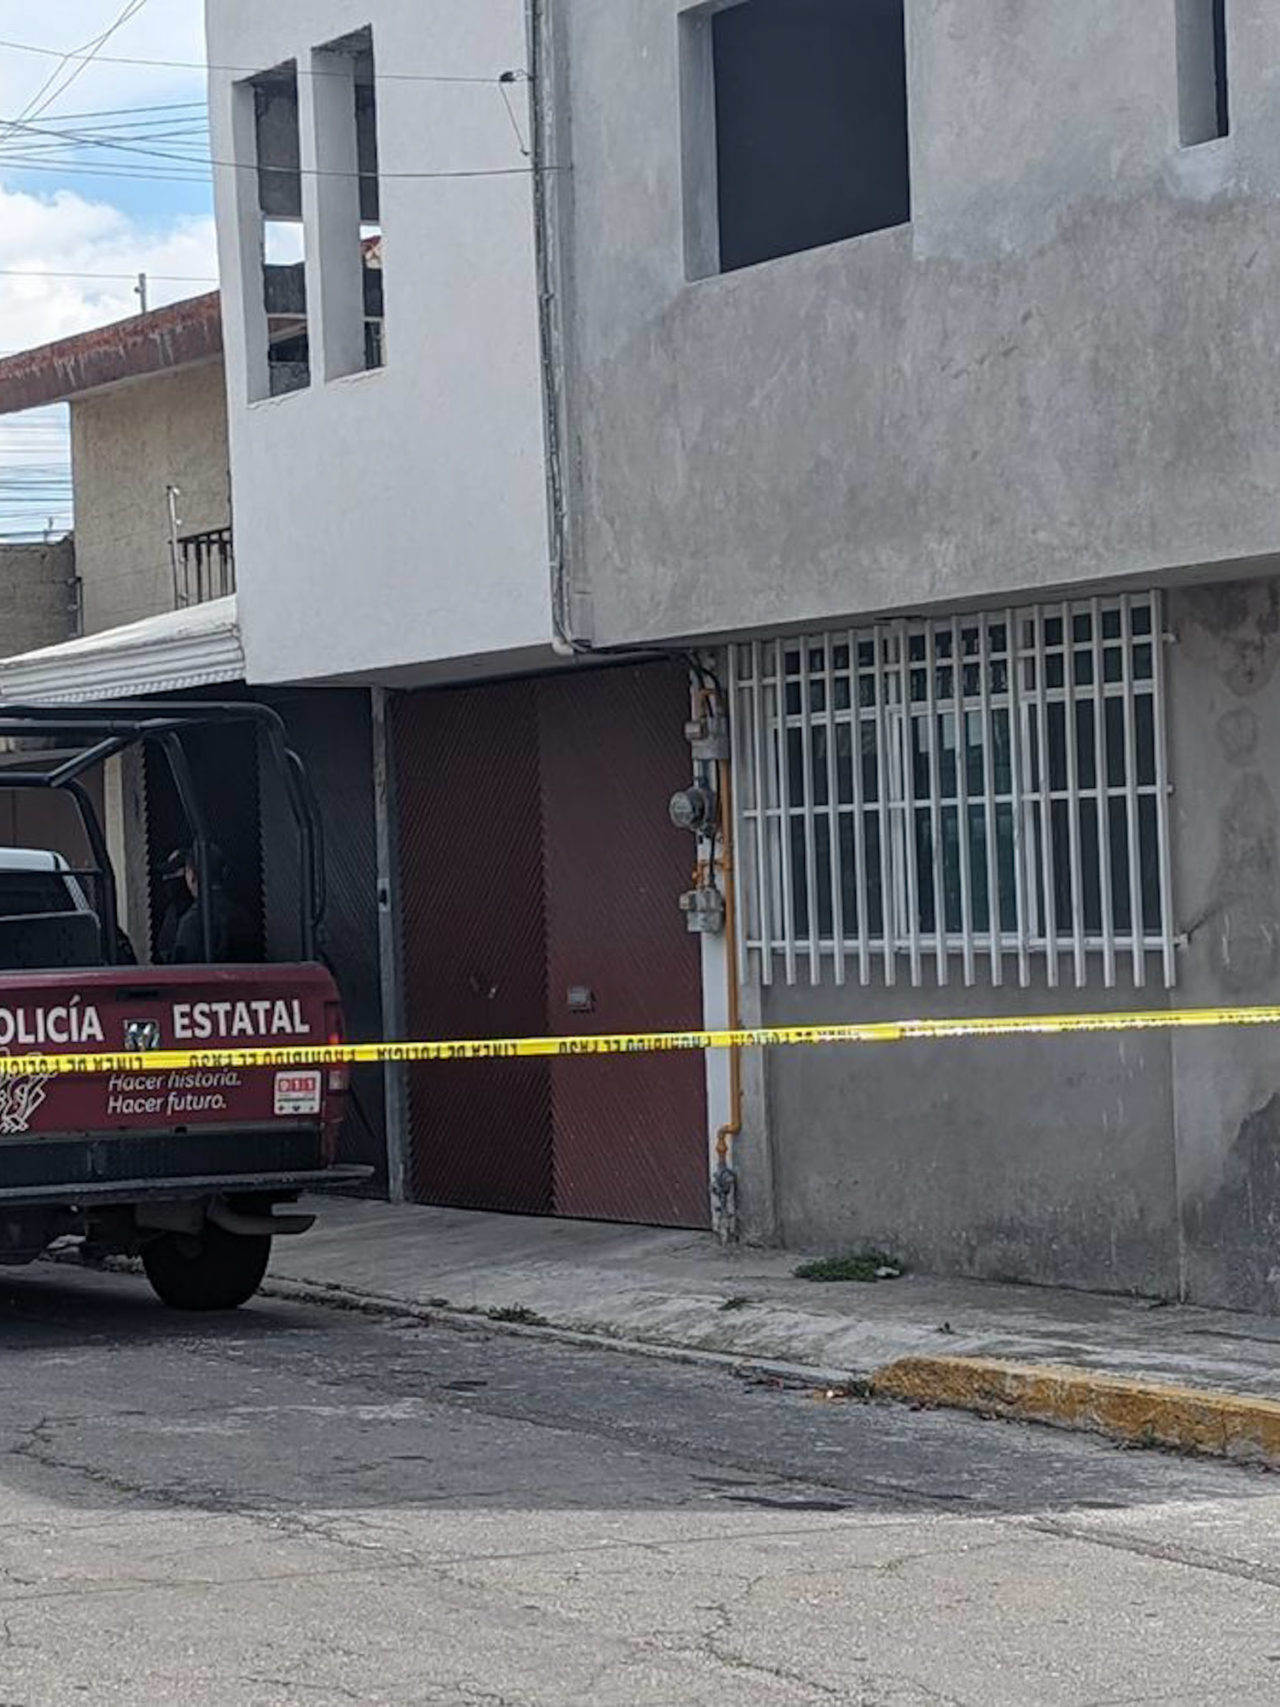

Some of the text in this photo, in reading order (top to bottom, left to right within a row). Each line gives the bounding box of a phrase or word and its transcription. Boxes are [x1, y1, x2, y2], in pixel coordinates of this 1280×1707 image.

[173, 1000, 310, 1039] ESTATAL
[109, 1069, 241, 1093] Hacer historia.
[108, 1092, 227, 1115] Hacer futuro.
